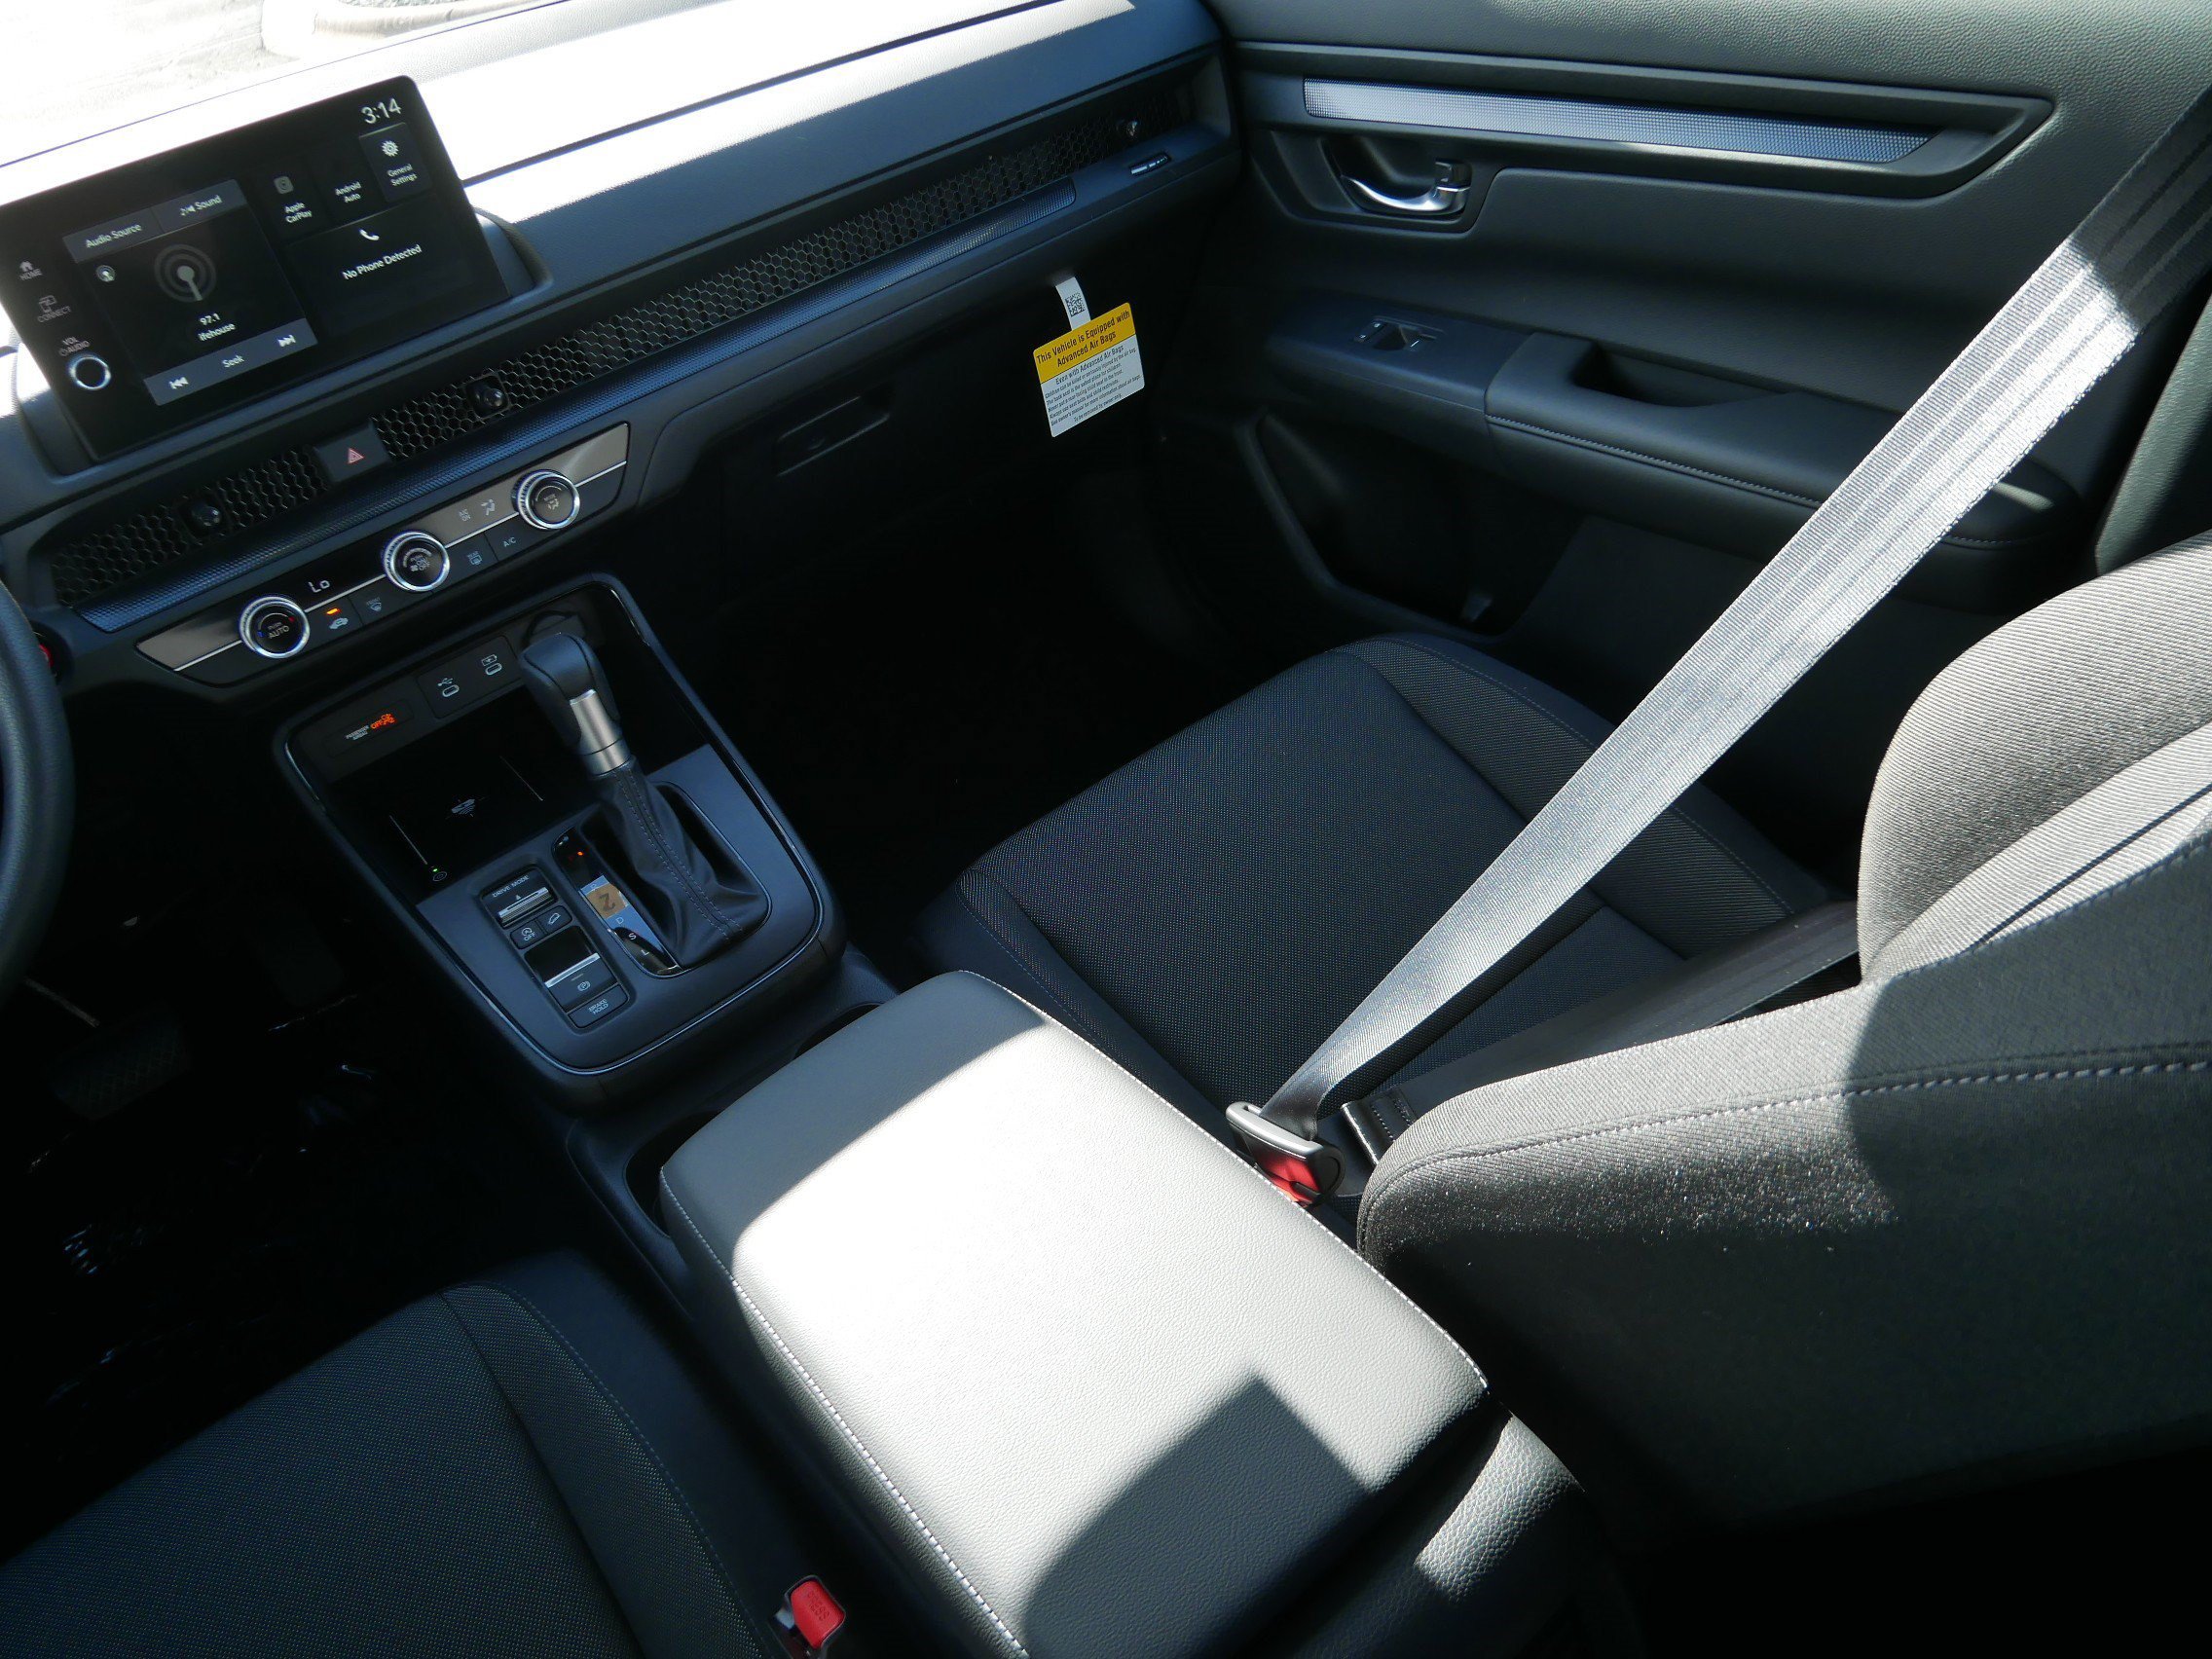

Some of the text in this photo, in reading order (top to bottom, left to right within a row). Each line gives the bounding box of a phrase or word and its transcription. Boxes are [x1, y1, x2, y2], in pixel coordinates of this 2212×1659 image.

[361, 97, 402, 125] 3:14
[387, 164, 414, 177] General
[390, 172, 418, 187] Settings
[335, 181, 362, 196] Android
[195, 195, 223, 211] Sound
[344, 192, 361, 203] Auto
[284, 202, 306, 214] Apple
[285, 209, 313, 224] CarPlay
[85, 223, 143, 248] Audio Source
[343, 243, 423, 280] No Phone Detected
[18, 268, 43, 281] HOME
[37, 306, 72, 323] CONNECT
[199, 313, 221, 326] 97.1
[1036, 310, 1129, 364] This Vehicle is Equipped with
[67, 340, 92, 353] AUDIO
[1056, 331, 1116, 367] Advanced Air Bags
[222, 354, 245, 368] Seek
[1054, 375, 1067, 385] Even
[1079, 355, 1103, 372] Advanced
[1111, 345, 1124, 356] Bags
[503, 536, 516, 548] A/C
[308, 579, 331, 594] Lo
[268, 625, 290, 640] AUTO
[492, 874, 531, 898] DRIVE MODE
[615, 916, 624, 925] D
[628, 932, 637, 940] S
[588, 998, 608, 1012] BRAKE
[592, 1003, 608, 1014] HOLD
